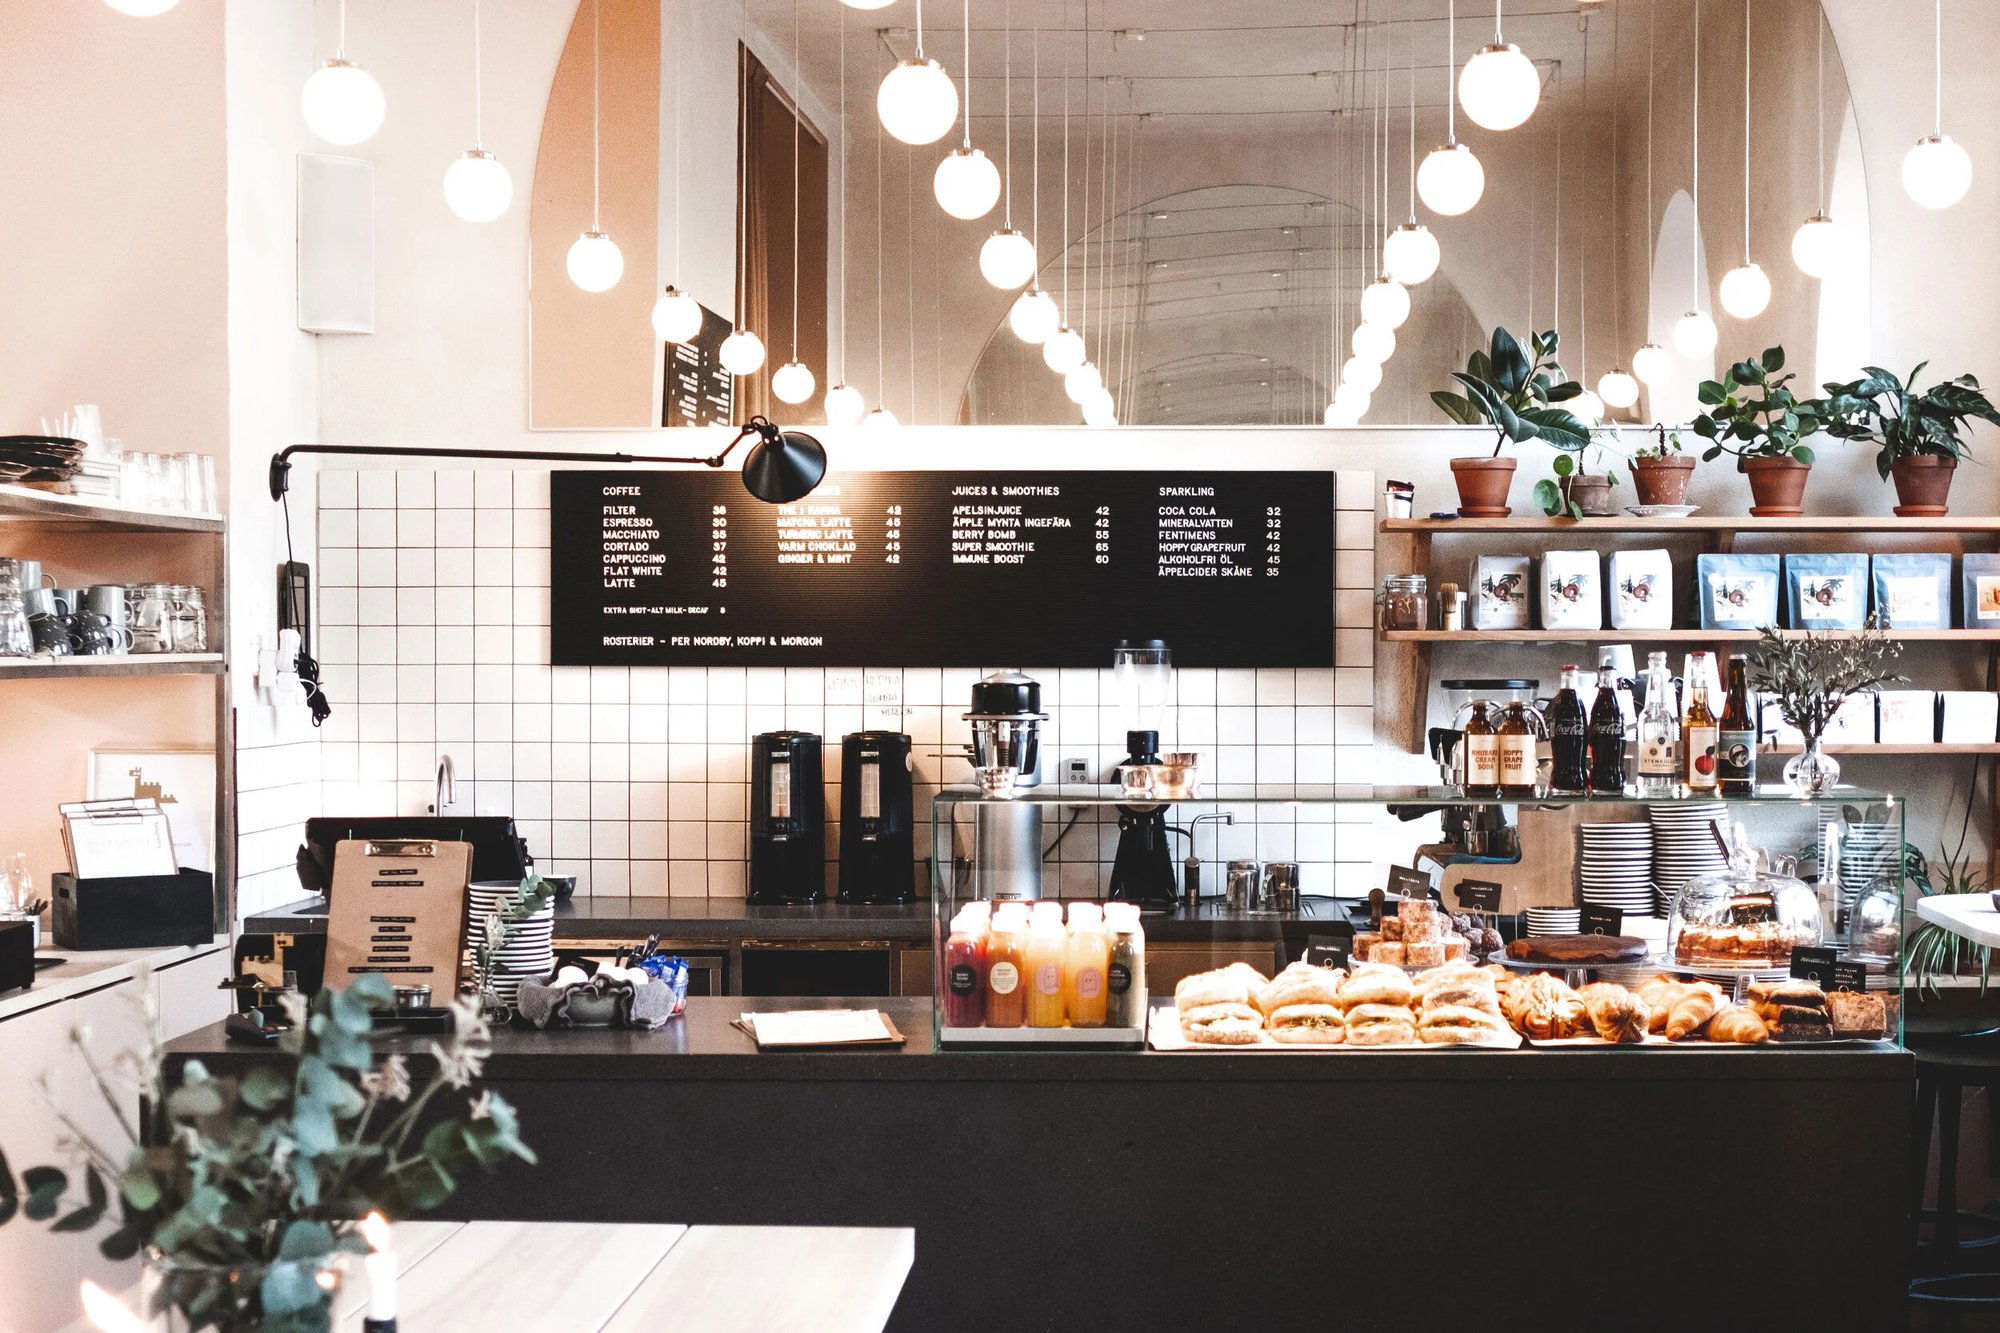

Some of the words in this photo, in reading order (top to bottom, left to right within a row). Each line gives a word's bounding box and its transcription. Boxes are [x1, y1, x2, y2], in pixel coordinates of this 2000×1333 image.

[602, 486, 641, 496] COFFEE
[951, 486, 988, 496] JUICES
[990, 486, 999, 496] &
[1002, 486, 1060, 496] SMOOTHIES
[1159, 486, 1215, 497] SPARKLING
[603, 505, 636, 515] FILTER
[886, 505, 902, 516] 42
[952, 505, 1023, 516] APELSINJUICE
[1095, 506, 1110, 516] 42
[1158, 506, 1186, 516] COCA
[1188, 506, 1217, 516] COLA
[1266, 506, 1281, 516] 32
[603, 517, 653, 528] ESPRESSO
[712, 517, 727, 528] 30
[820, 517, 851, 528] LATTE
[987, 517, 1021, 528] MYNTA
[1094, 518, 1110, 528] 42
[1158, 518, 1233, 528] MINERALVATTEN
[1266, 518, 1281, 528] 32
[602, 529, 660, 540] MACCHIATO
[712, 529, 727, 540] 35
[824, 529, 854, 540] LATTE
[952, 529, 985, 540] BERRY
[987, 529, 1017, 540] BOMB
[1095, 530, 1110, 540] 55
[1158, 530, 1216, 540] FENTIMENS
[1266, 531, 1281, 540] 42
[603, 541, 650, 552] CORTADO
[712, 541, 727, 552] 37
[777, 541, 806, 552] VARM
[807, 541, 857, 552] CHOKLAD
[951, 541, 983, 552] SUPER
[985, 541, 1035, 552] SMOOTHIE
[1095, 542, 1109, 552] 65
[1266, 543, 1281, 553] 42
[602, 554, 667, 564] CAPPUCCINO
[711, 553, 726, 564] 42
[777, 553, 814, 564] GINGER
[816, 553, 825, 564] &
[827, 553, 852, 564] MINT
[885, 553, 900, 564] 42
[952, 554, 990, 564] IMMUNE
[993, 554, 1025, 564] BOOST
[1095, 554, 1110, 564] 60
[1158, 554, 1217, 565] ALKOHOLFRI
[603, 566, 630, 576] FLAT
[631, 566, 663, 576] WHITE
[712, 566, 728, 576] 42
[1220, 565, 1253, 577] SKÅNE
[1266, 567, 1279, 577] 35
[603, 578, 636, 588] LATTE
[603, 606, 628, 614] EXTRA
[603, 636, 654, 646] ROSTERIER
[671, 636, 691, 646] PER
[736, 636, 766, 647] KOPPI
[769, 636, 777, 646] &
[781, 636, 823, 646] MORGON
